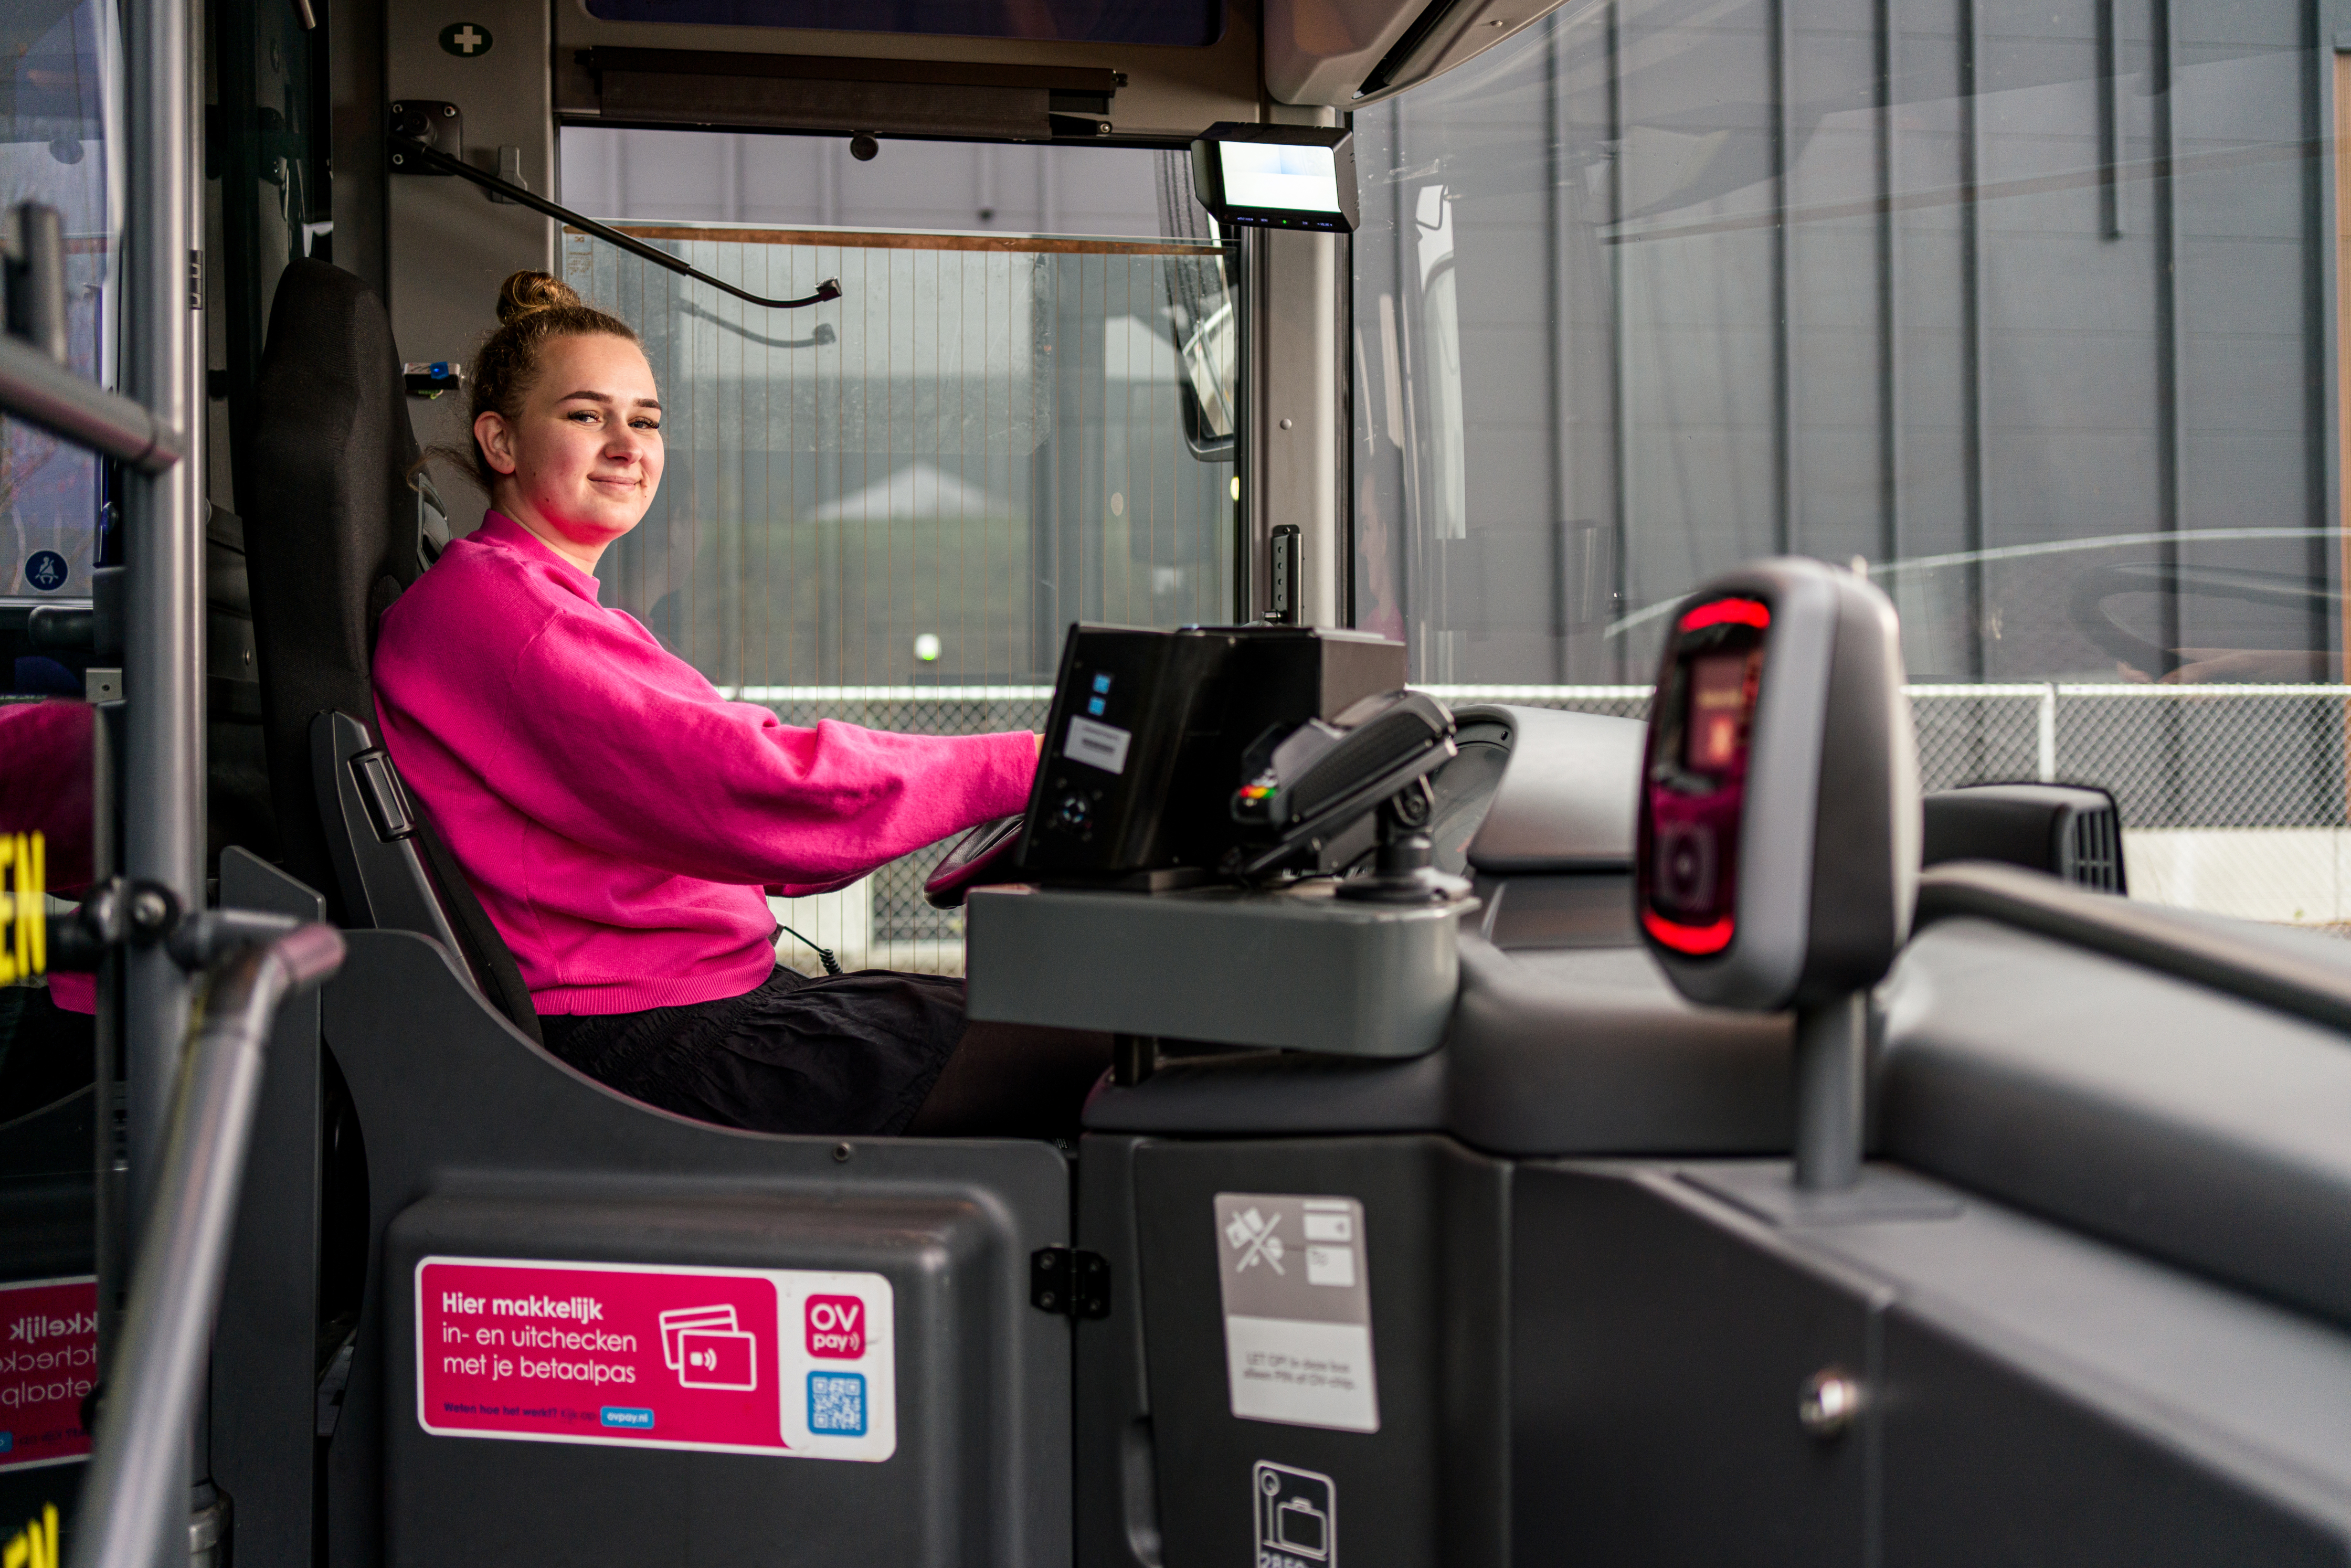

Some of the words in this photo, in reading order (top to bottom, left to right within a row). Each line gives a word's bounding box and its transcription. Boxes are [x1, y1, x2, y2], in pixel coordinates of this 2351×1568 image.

[443, 1291, 486, 1314] Hier
[492, 1295, 603, 1325] makkelijk
[810, 1302, 859, 1332] OV
[443, 1321, 470, 1343] in-
[476, 1328, 505, 1345] en
[512, 1325, 637, 1352] uitchecken
[813, 1333, 849, 1352] pay
[444, 1354, 486, 1375] met
[492, 1354, 513, 1381] je
[521, 1355, 636, 1386] betaalpas
[444, 1402, 476, 1414] Weten
[480, 1403, 500, 1415] hoe
[503, 1405, 520, 1416] het
[522, 1407, 557, 1418] werkt?
[607, 1411, 648, 1424] ovpay.nl
